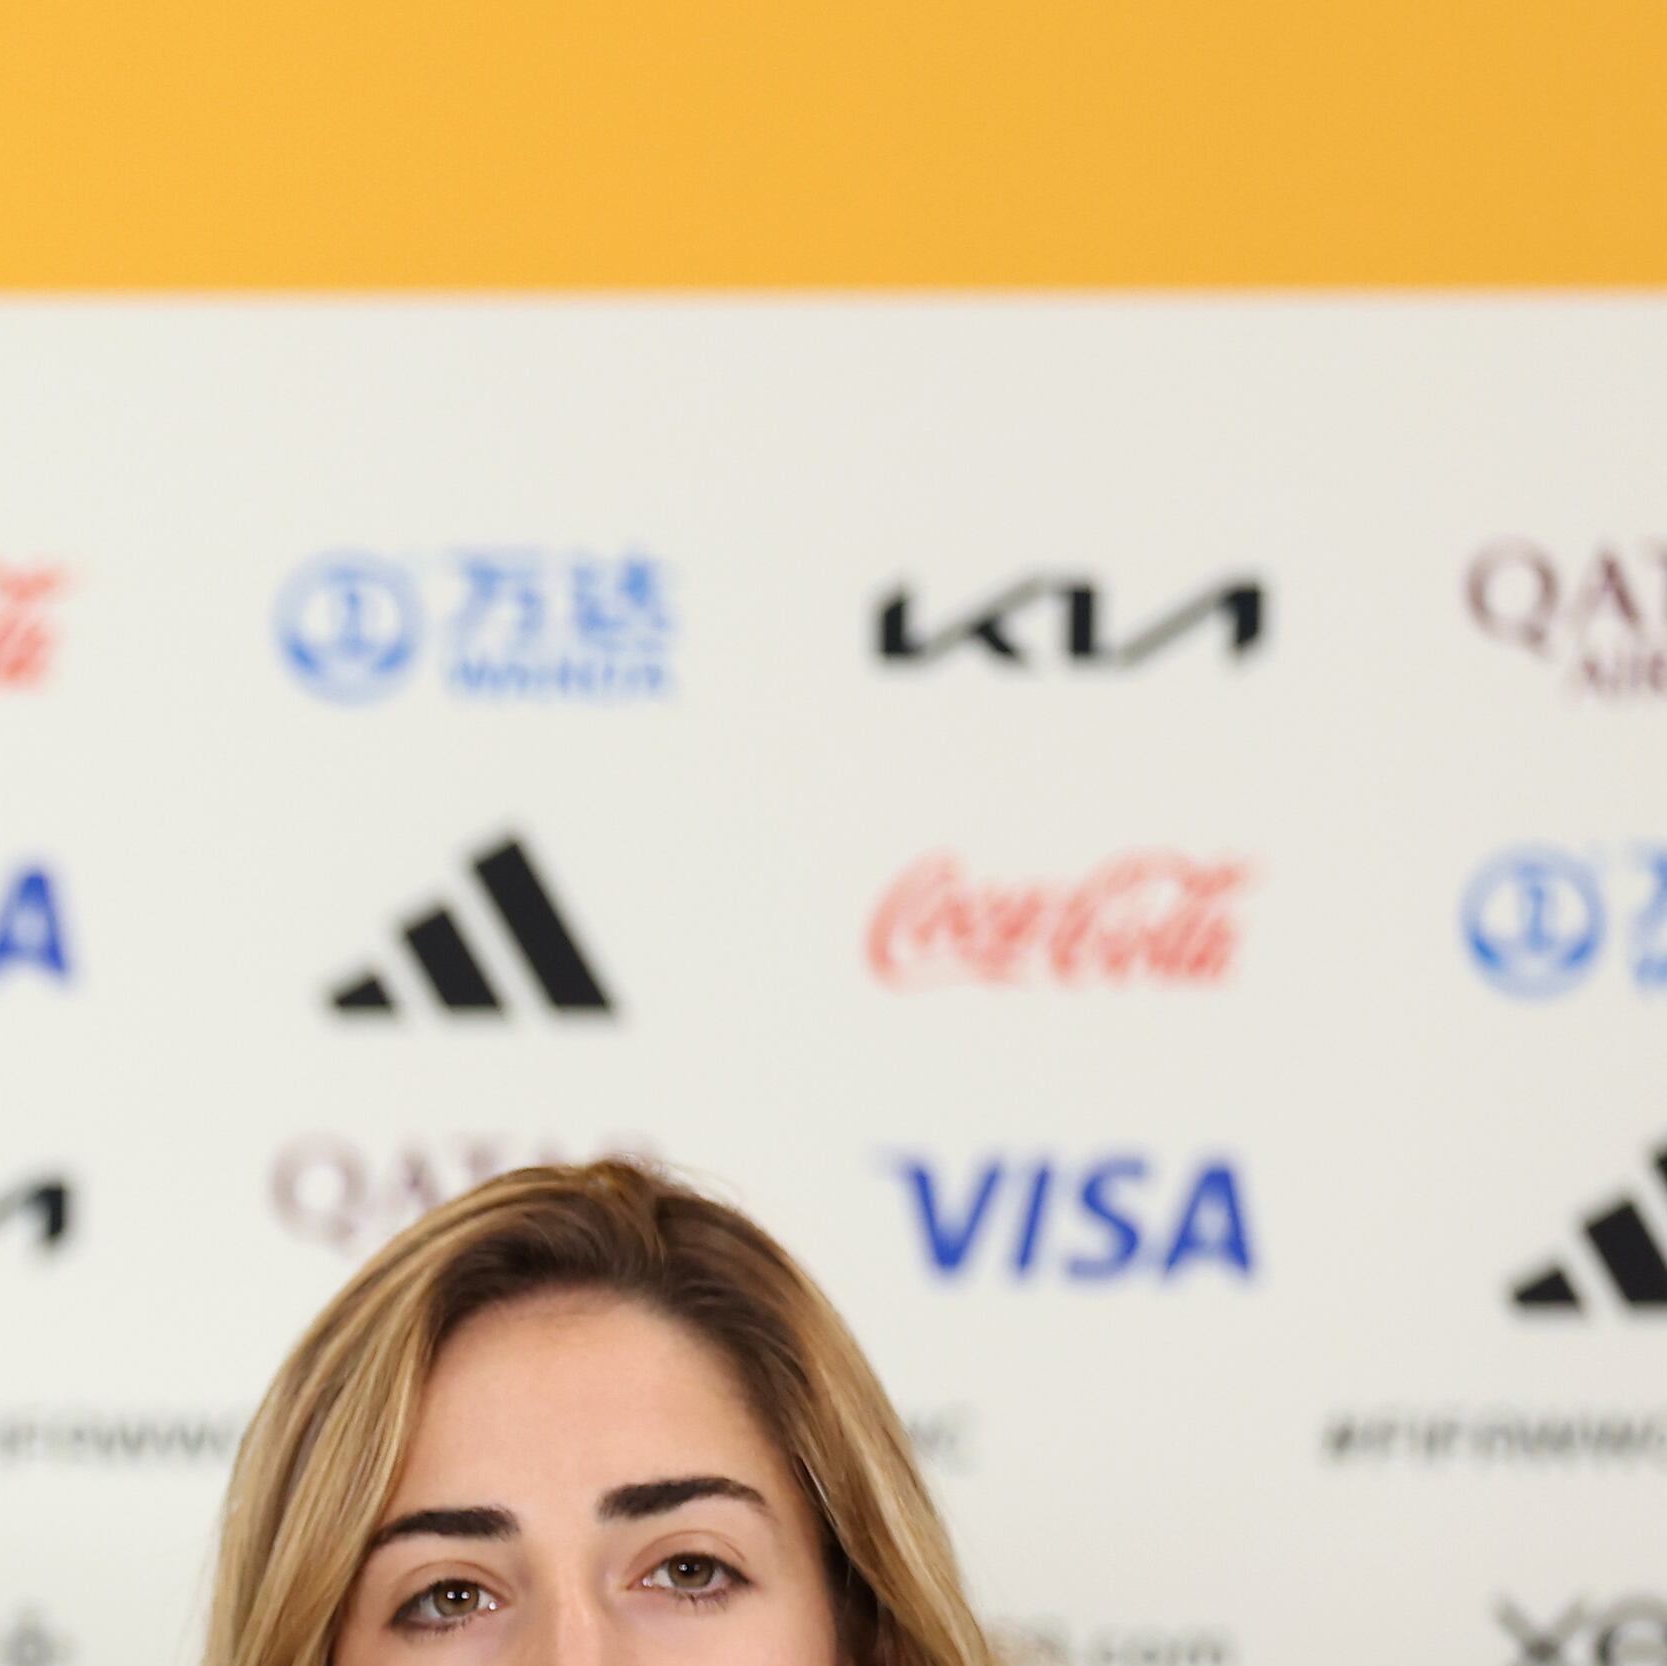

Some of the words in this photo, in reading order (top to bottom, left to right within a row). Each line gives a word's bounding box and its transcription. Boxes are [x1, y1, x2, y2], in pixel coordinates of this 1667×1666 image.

[872, 577, 1268, 667] KIA
[863, 854, 1250, 986] Coca-Cola
[897, 1154, 1257, 1283] VISA
